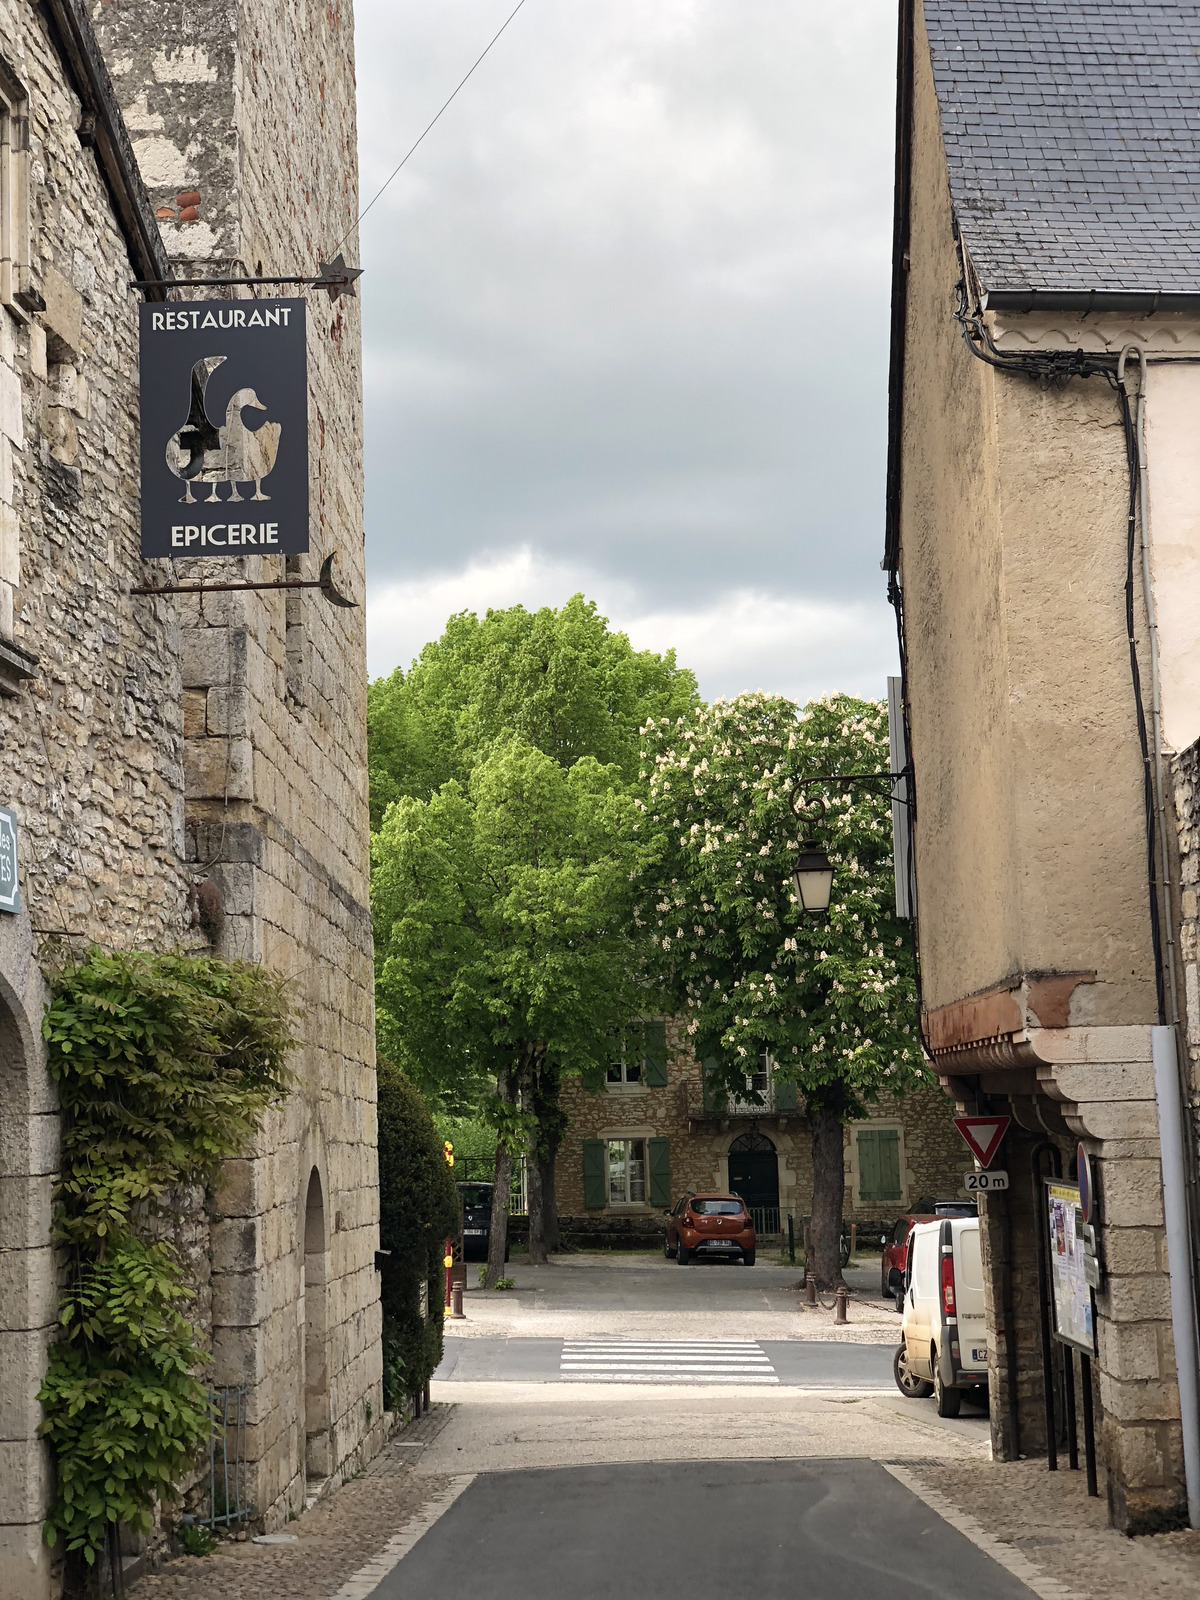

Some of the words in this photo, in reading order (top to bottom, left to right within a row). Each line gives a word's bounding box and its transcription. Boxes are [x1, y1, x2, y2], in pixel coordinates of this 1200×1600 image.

[152, 308, 291, 331] RESTAURANT
[171, 522, 279, 547] EPICERIE
[0, 821, 10, 851] es
[0, 852, 11, 882] ES
[968, 1174, 989, 1189] 20
[992, 1178, 1005, 1188] m
